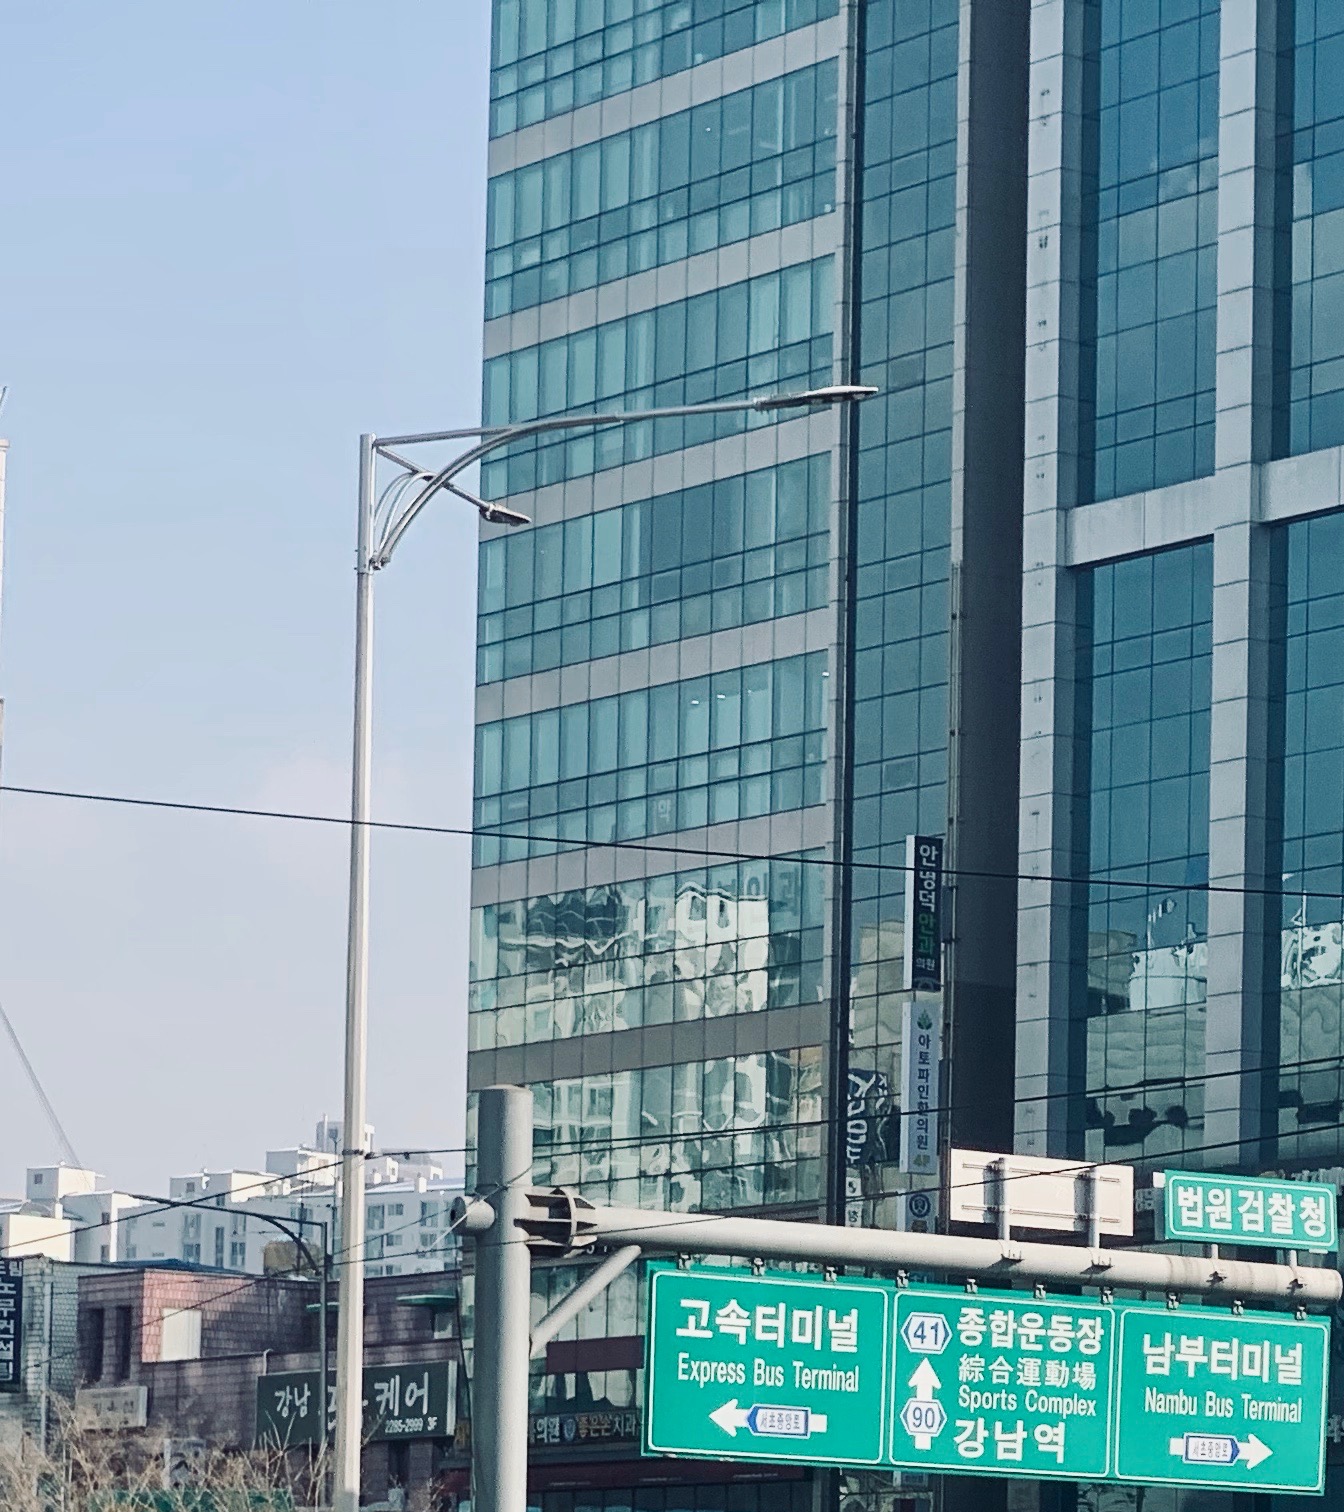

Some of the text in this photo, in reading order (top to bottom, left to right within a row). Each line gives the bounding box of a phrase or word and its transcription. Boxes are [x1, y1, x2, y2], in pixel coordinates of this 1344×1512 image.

[1176, 1186, 1327, 1238] 법원검찰청
[676, 1299, 858, 1353] 고속터미널
[913, 1320, 939, 1345] 41
[957, 1307, 1104, 1355] 종합운동장
[678, 1352, 859, 1392] Express Bus Terminal
[958, 1353, 1097, 1391] 綜合運動場
[1143, 1332, 1303, 1386] 남부터미널
[275, 1382, 311, 1418] 강남
[912, 1406, 935, 1429] 90
[958, 1385, 1097, 1419] Sports Complex
[1144, 1387, 1302, 1424] Nambu Bus Terminal
[954, 1417, 1066, 1464] 강남역
